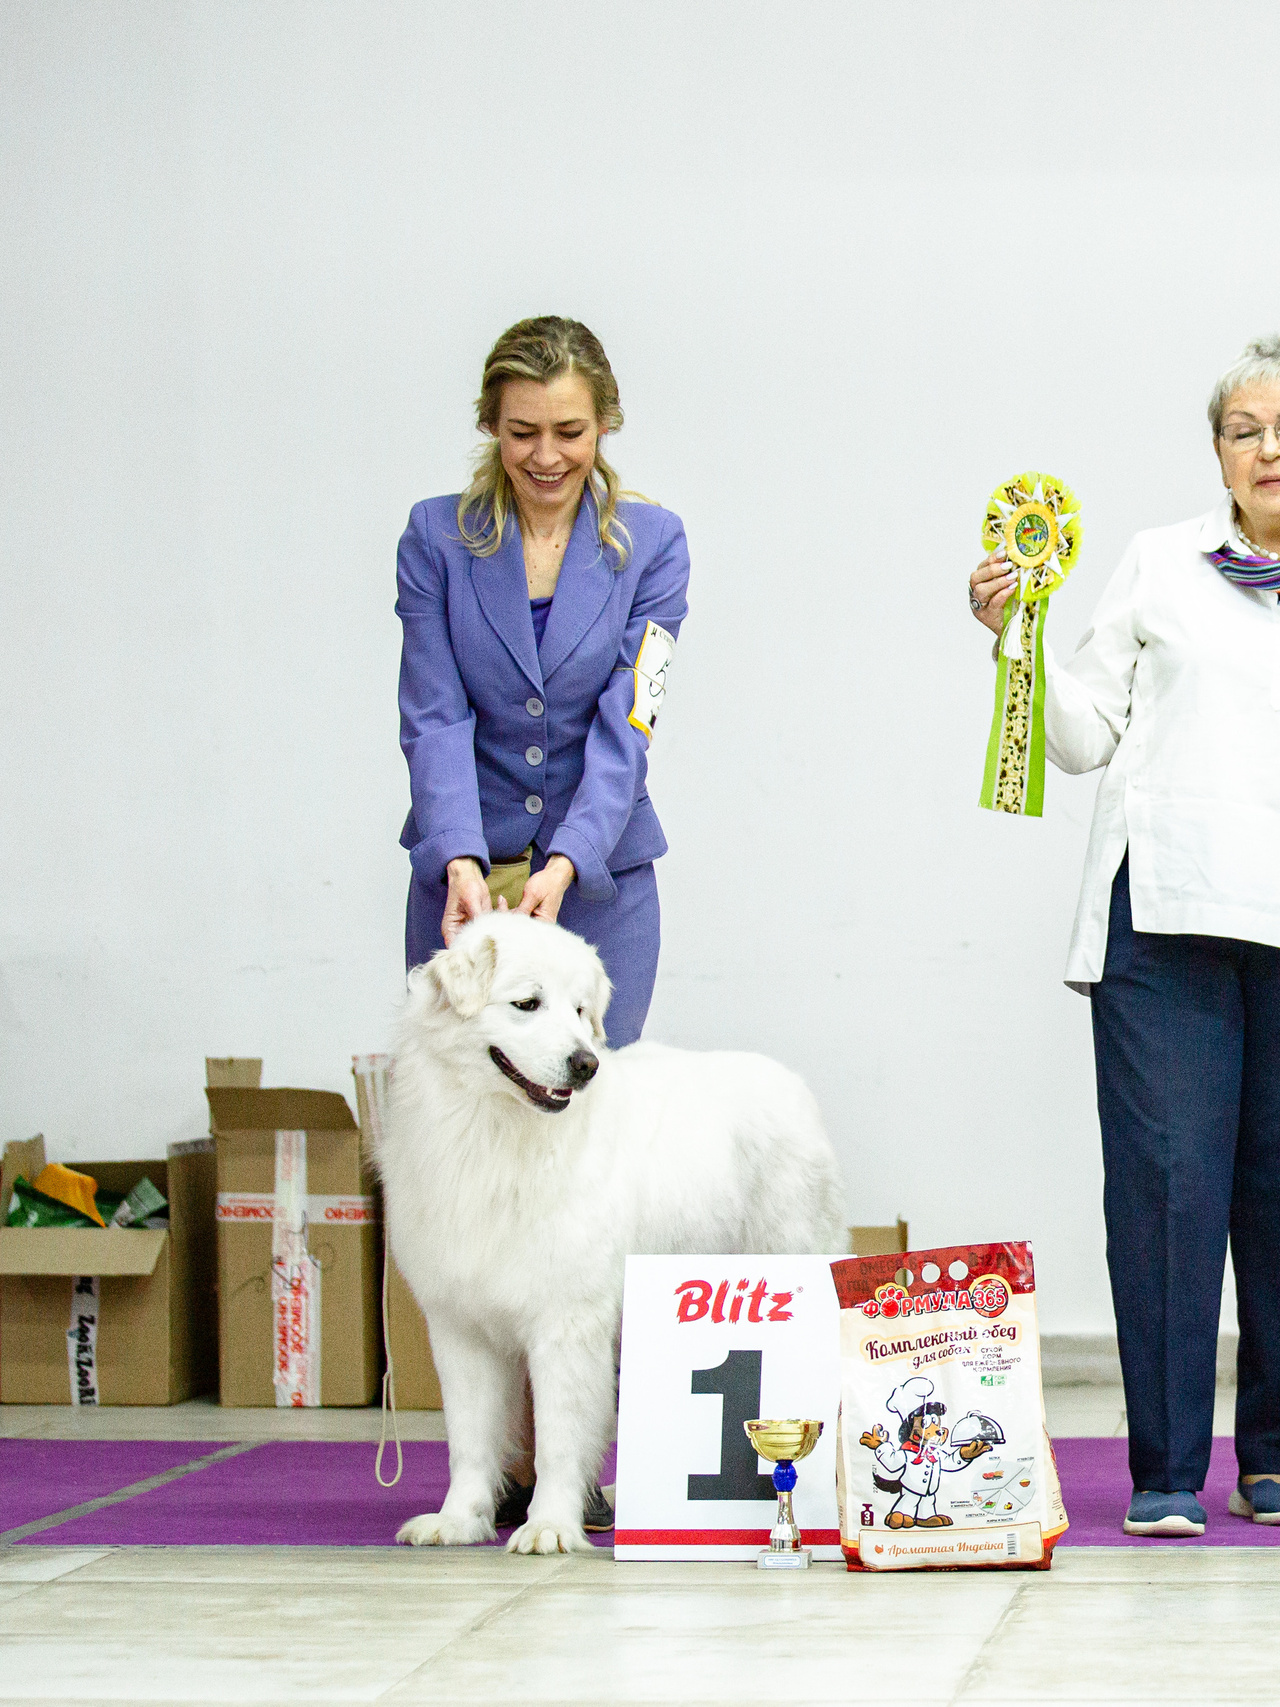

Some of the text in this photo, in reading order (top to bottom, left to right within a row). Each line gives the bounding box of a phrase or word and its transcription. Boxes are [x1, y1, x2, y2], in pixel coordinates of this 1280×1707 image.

[674, 1277, 794, 1324] Blitz
[974, 1288, 1005, 1308] 365
[866, 1324, 1016, 1360] Комплексный обед
[912, 1351, 937, 1370] для
[687, 1349, 779, 1501] 1
[864, 1510, 871, 1520] 3
[888, 1541, 1004, 1557] Ароматная Индейка
